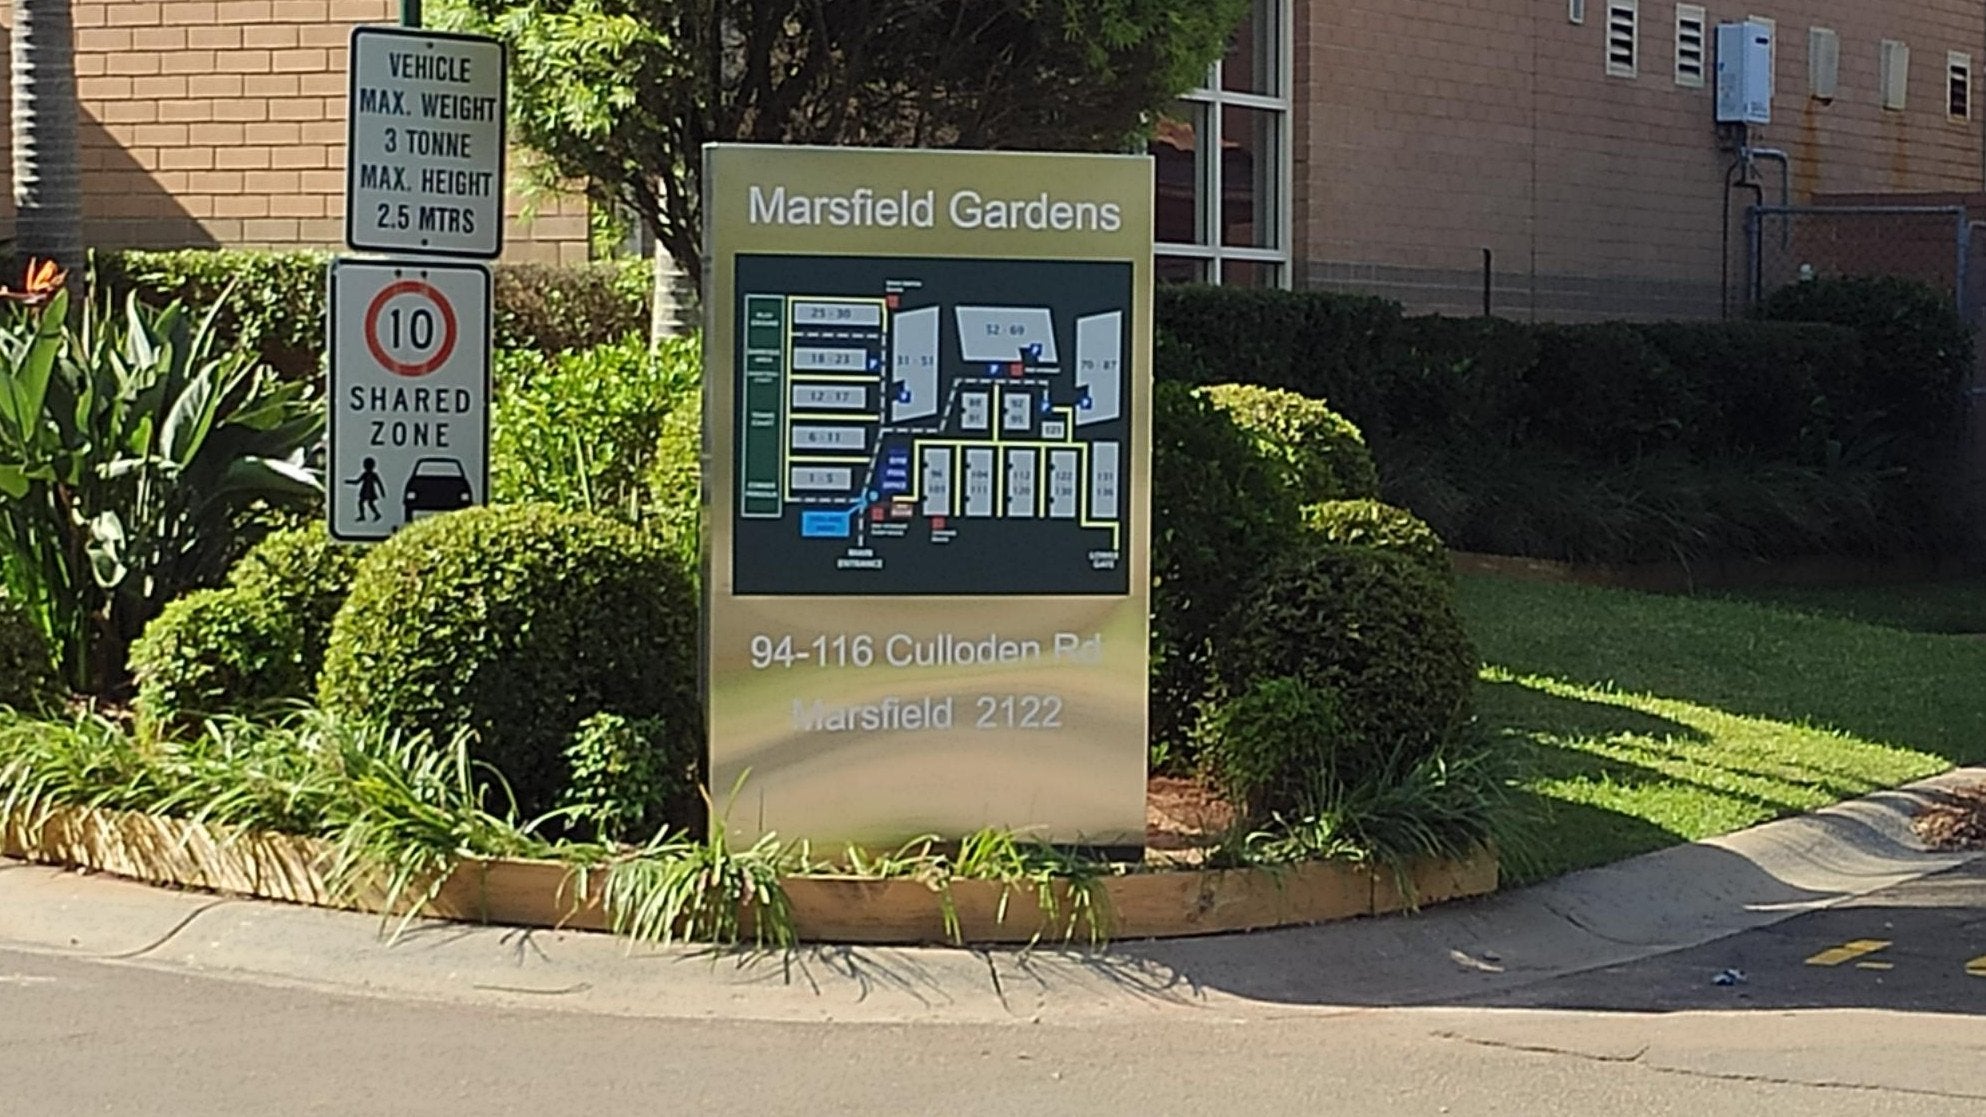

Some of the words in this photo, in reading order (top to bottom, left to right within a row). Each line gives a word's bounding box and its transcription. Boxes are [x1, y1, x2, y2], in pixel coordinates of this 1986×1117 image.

[389, 52, 471, 83] VEHICLE
[360, 88, 411, 115] MAX.
[421, 93, 497, 122] WEIGHT
[384, 128, 397, 153] 3
[406, 129, 471, 158] TONNE
[360, 164, 411, 192] MAX.
[421, 168, 492, 197] HEIGHT
[377, 203, 410, 230] 2.5
[418, 206, 475, 234] MTRS
[748, 185, 935, 228] Marsfield
[949, 189, 1122, 231] Gardens
[390, 308, 434, 349] 10
[350, 386, 471, 414] SHARED
[370, 421, 450, 447] ZONE
[749, 634, 874, 669] 94-116
[885, 632, 1040, 669] Culloden
[1053, 632, 1102, 664] Rd
[791, 695, 953, 732] Marsfield
[975, 695, 1064, 730] 2122
